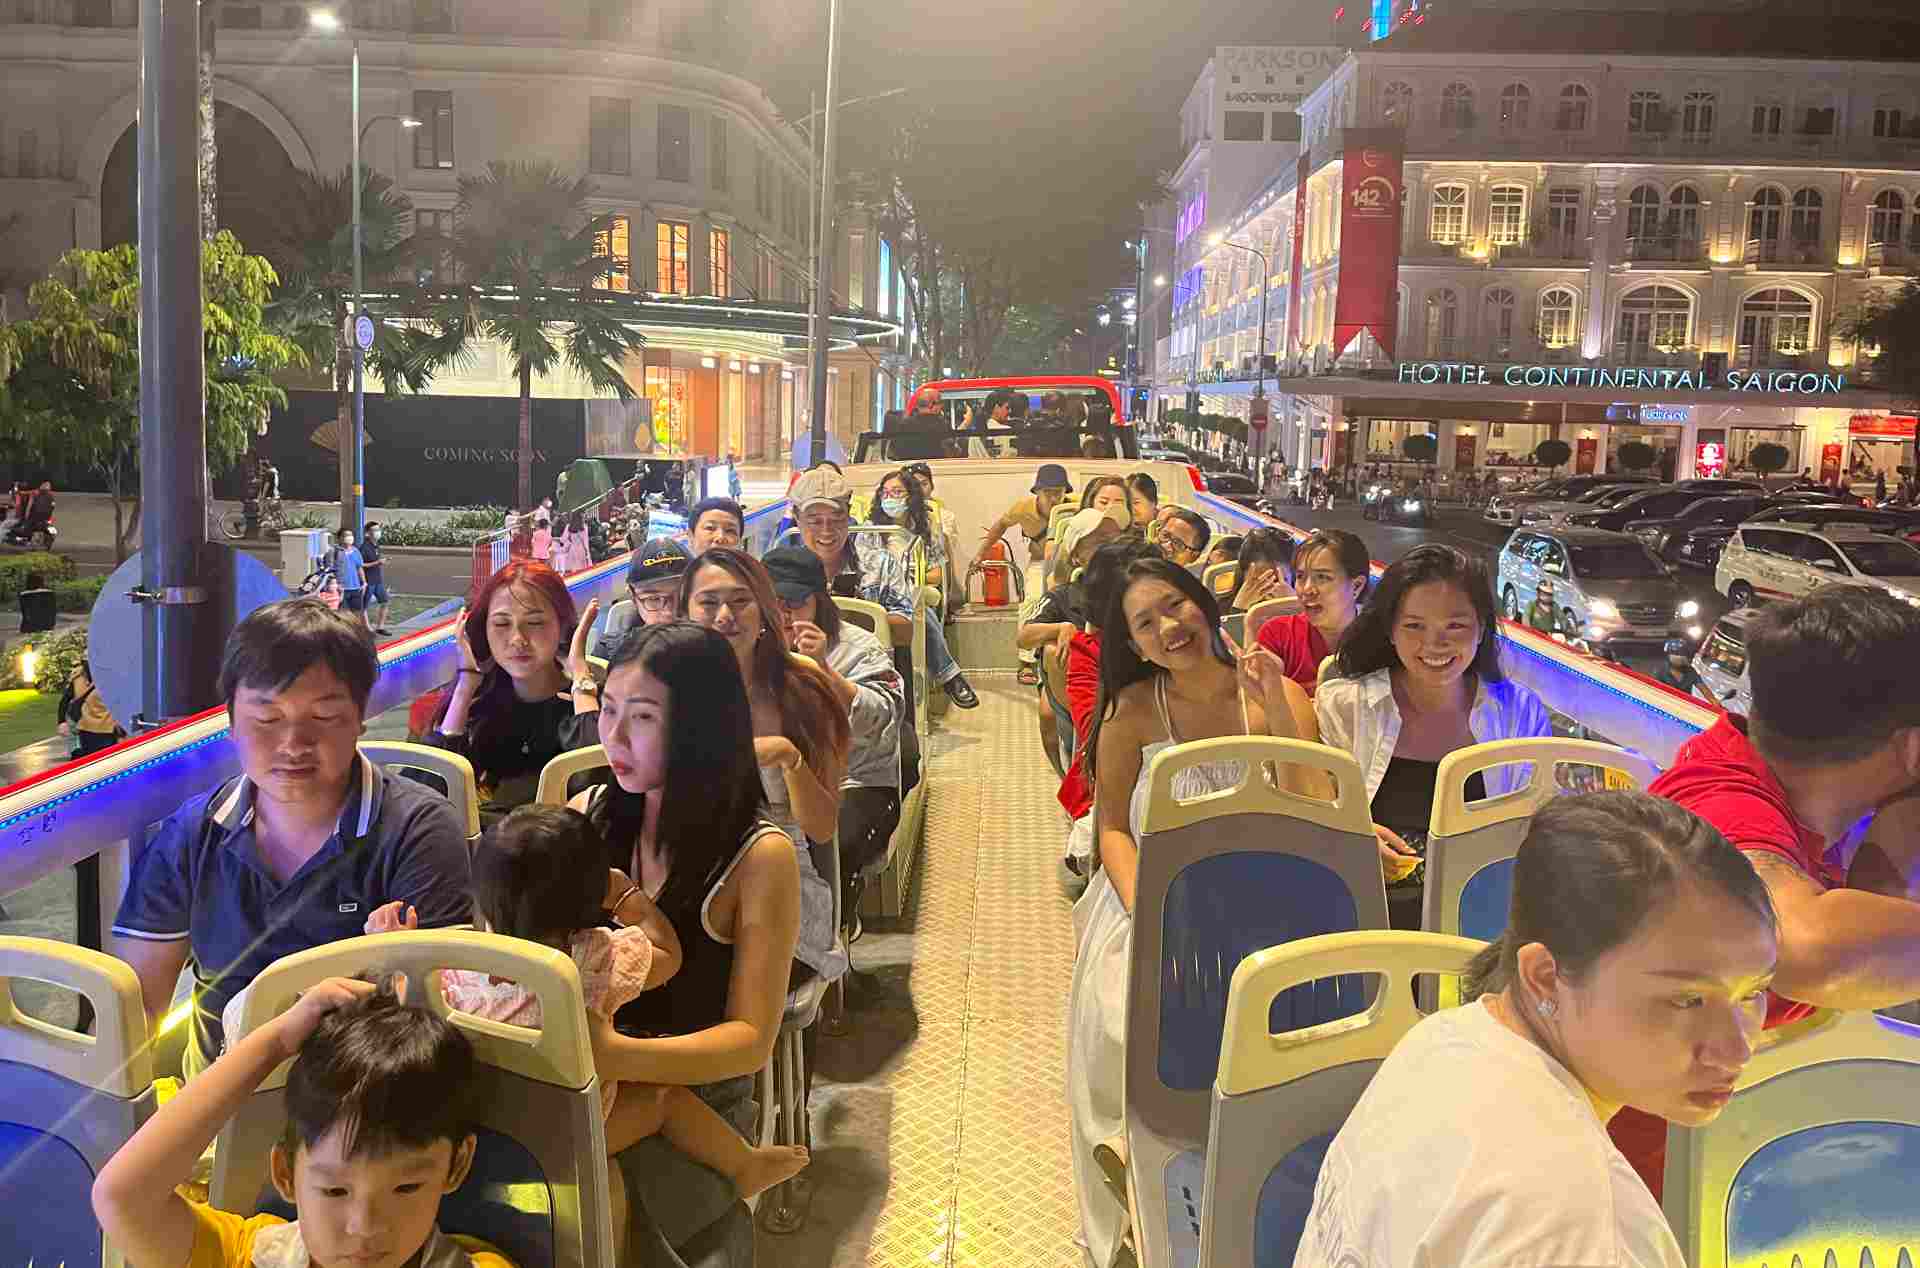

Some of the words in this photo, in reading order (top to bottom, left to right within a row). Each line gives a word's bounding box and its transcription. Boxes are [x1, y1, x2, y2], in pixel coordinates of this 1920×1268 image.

[1398, 362, 1491, 385] HOTEL
[1504, 366, 1712, 389] CONTINENTAL
[1727, 370, 1844, 393] SAIGON
[423, 447, 493, 462] COMING
